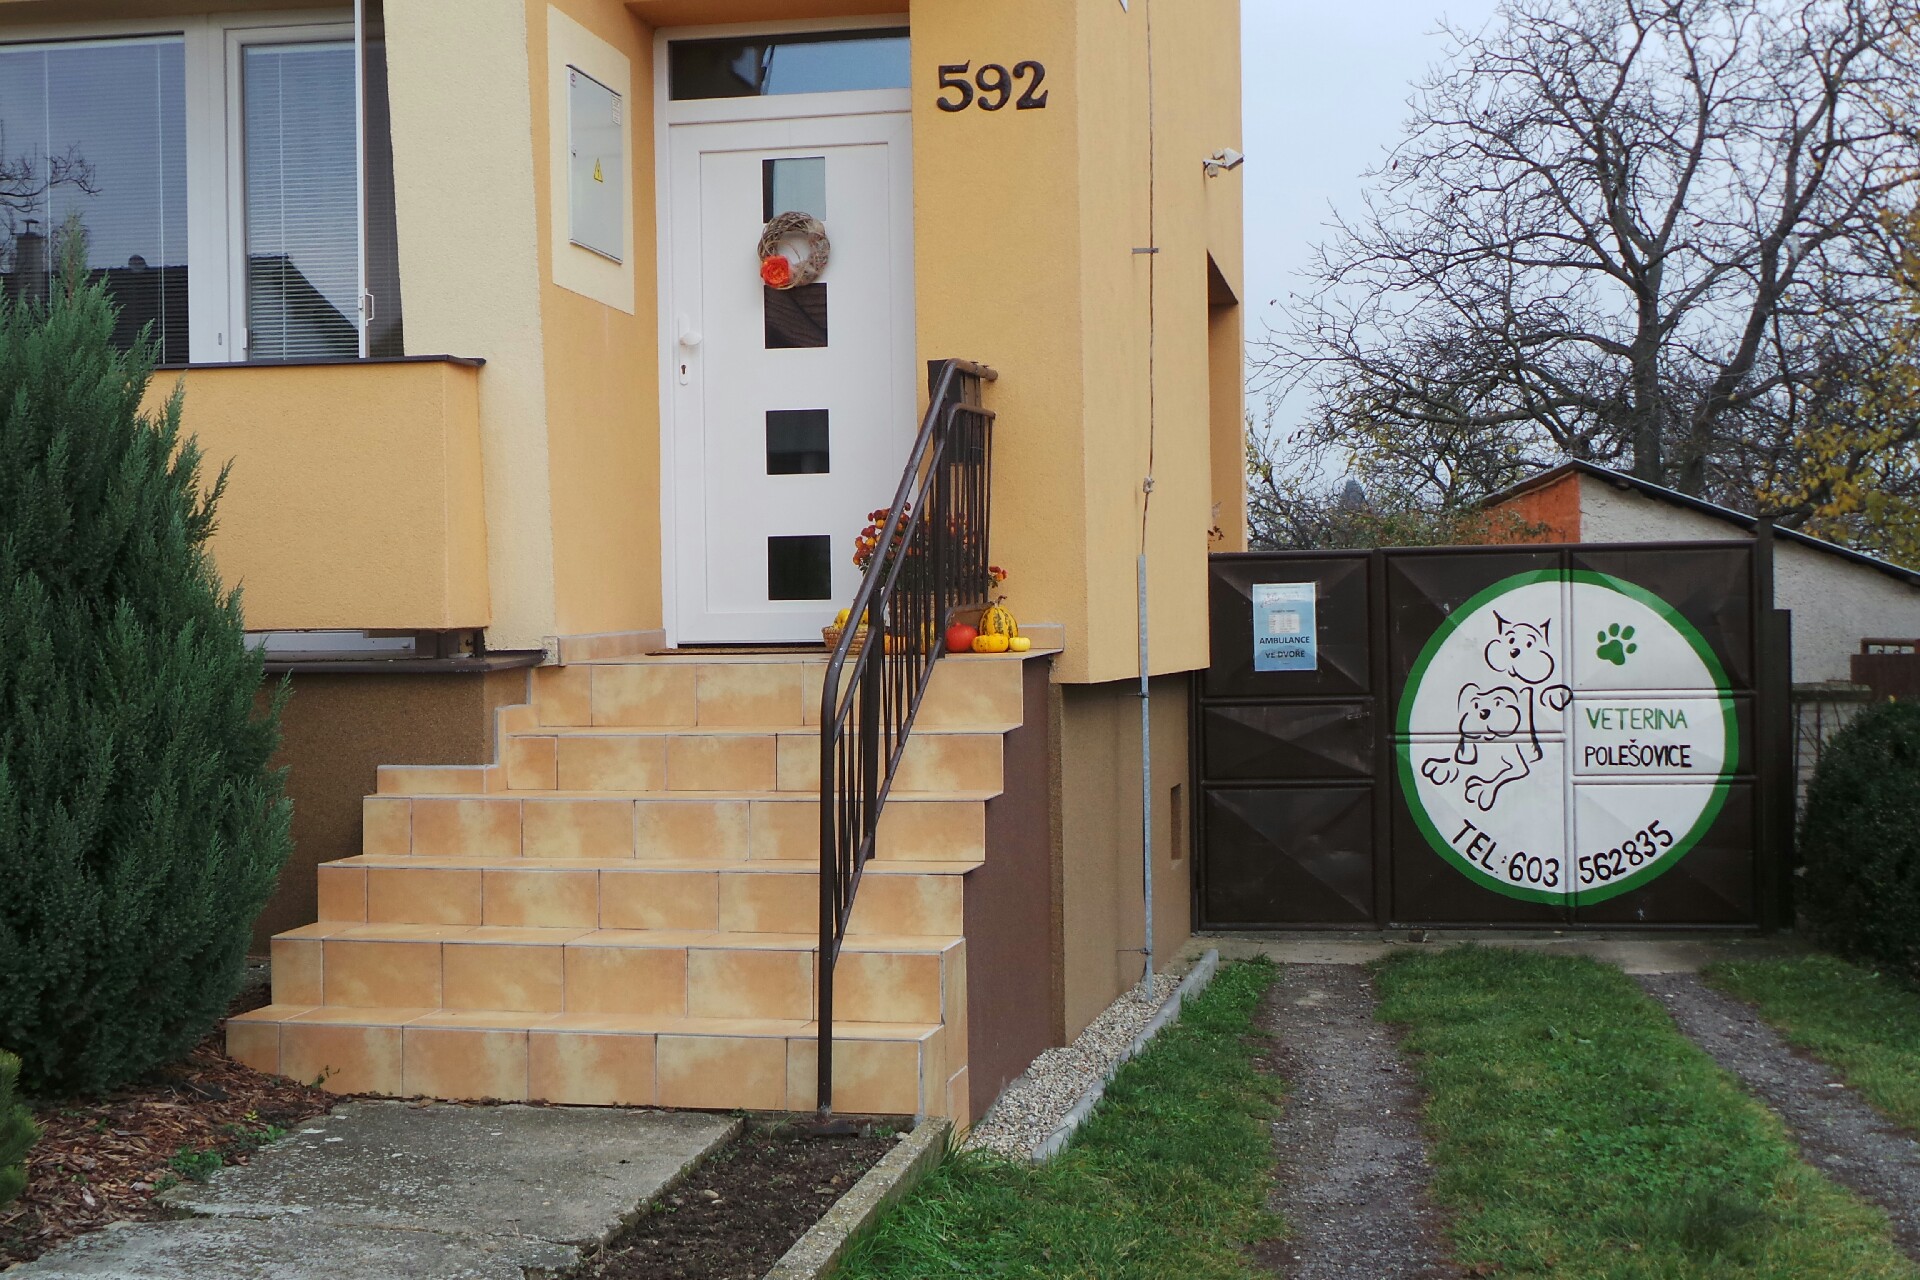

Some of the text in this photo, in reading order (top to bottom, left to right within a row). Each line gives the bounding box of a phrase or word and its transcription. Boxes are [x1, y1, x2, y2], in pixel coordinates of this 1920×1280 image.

[936, 59, 1049, 112] 592
[1259, 636, 1310, 644] AMBULANCE
[1585, 707, 1688, 730] VETERINA
[1584, 738, 1693, 768] POLEŠOVICE
[1578, 819, 1674, 884] 562835
